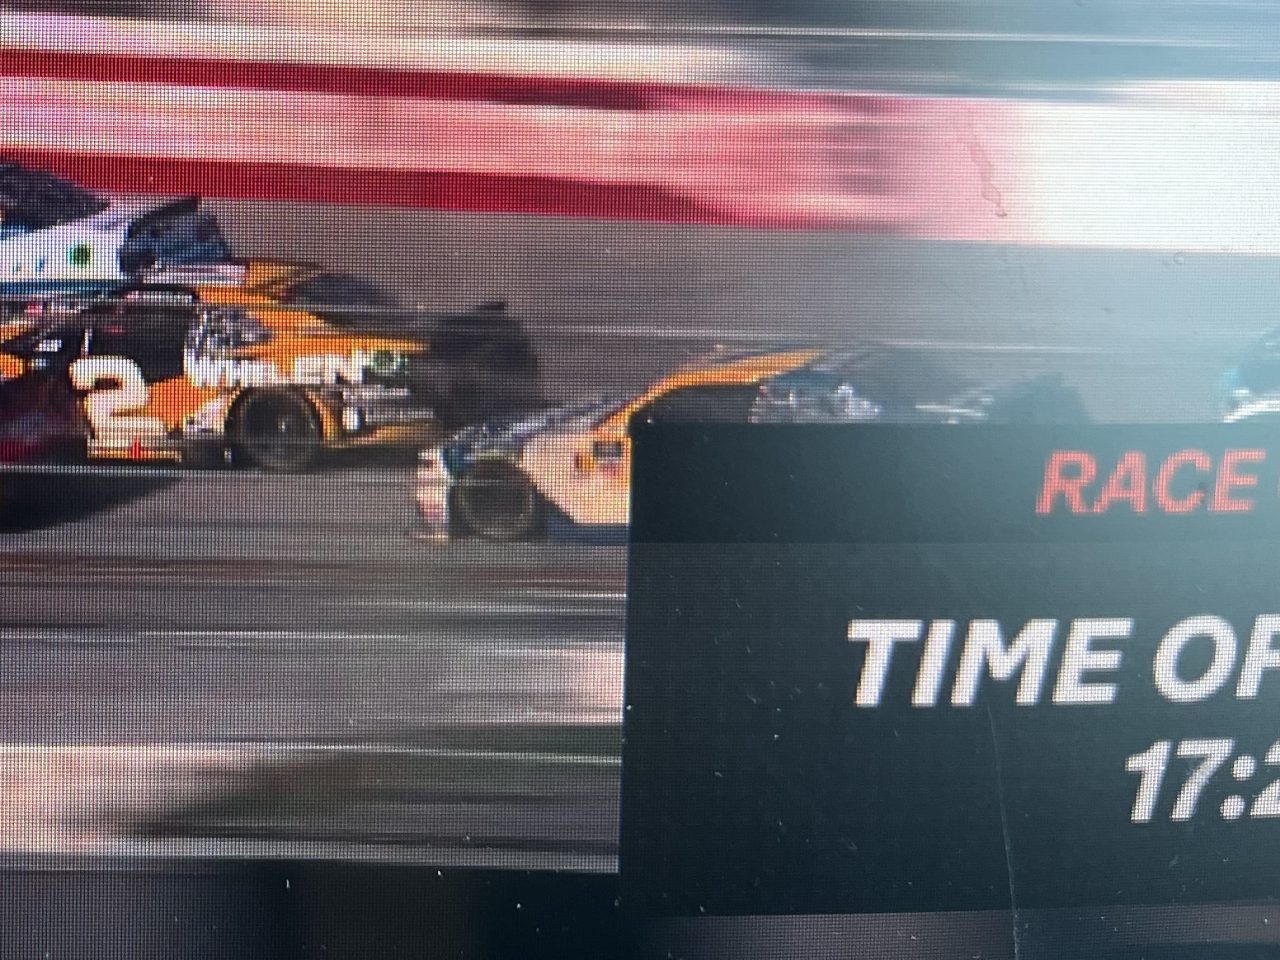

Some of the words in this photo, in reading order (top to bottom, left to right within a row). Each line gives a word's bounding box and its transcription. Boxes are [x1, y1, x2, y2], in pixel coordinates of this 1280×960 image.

[68, 355, 170, 437] 2
[1035, 448, 1267, 513] RACE
[848, 618, 1134, 708] TIME
